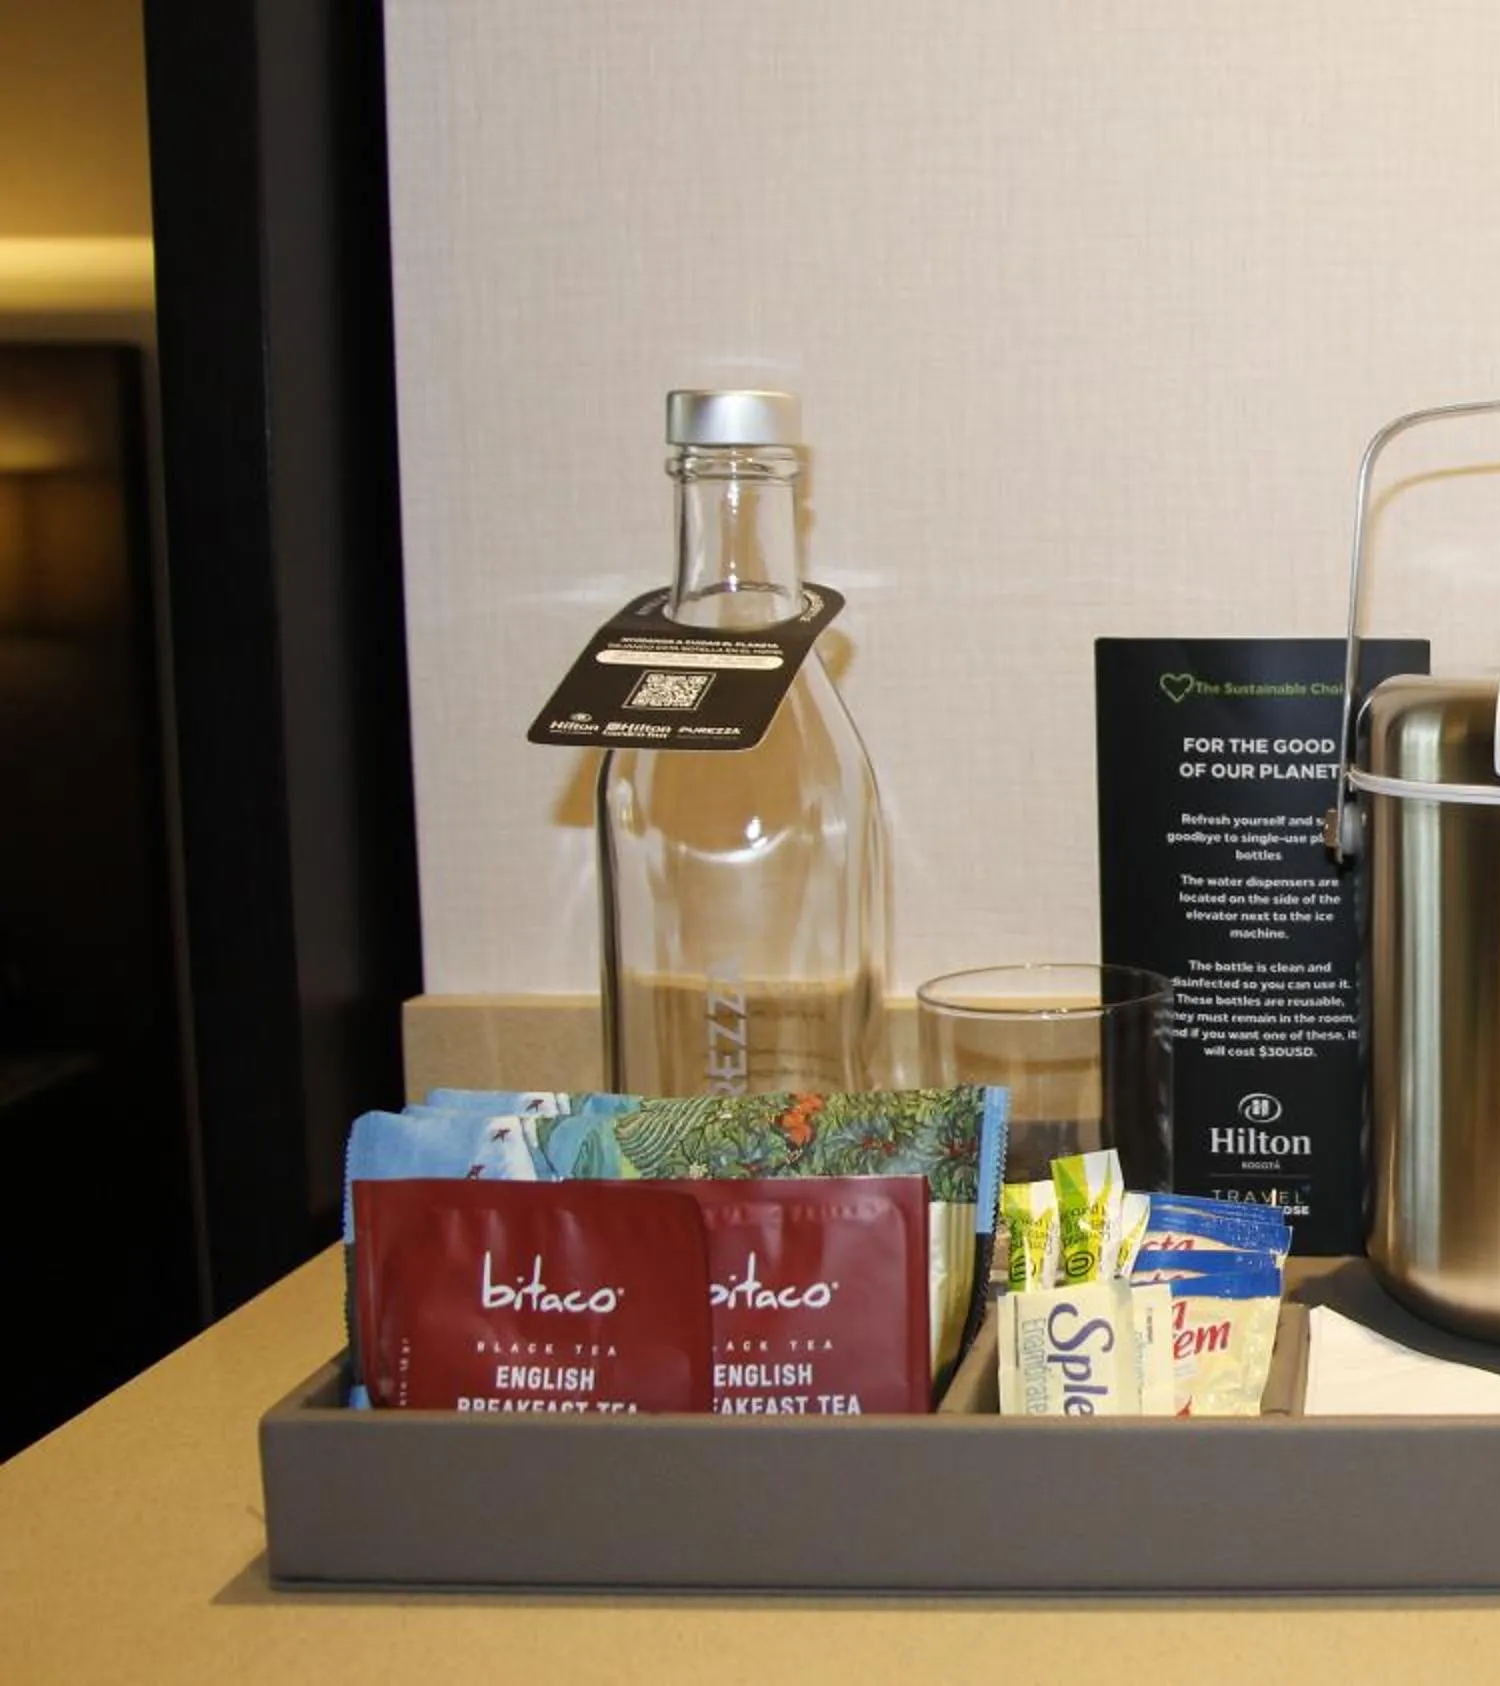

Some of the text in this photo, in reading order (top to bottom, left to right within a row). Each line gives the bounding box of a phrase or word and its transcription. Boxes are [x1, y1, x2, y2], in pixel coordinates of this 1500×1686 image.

[1196, 682, 1345, 695] The Sustainable Choi
[1184, 738, 1335, 754] FOR THE GOOD
[1180, 763, 1341, 781] OF OUR PLANET
[1182, 814, 1231, 825] Refresh
[1234, 816, 1286, 828] yourself
[1288, 816, 1313, 826] and
[1167, 832, 1221, 844] goodbye
[1224, 833, 1238, 842] to
[1241, 833, 1307, 845] single-use
[1236, 850, 1282, 860] bottles
[1181, 874, 1204, 885] The
[1207, 877, 1242, 886] water
[1246, 877, 1315, 888] dispensers
[1180, 892, 1341, 904] located on the side of the
[1186, 910, 1333, 921] elevator next to the ice
[1230, 928, 1288, 938] machine.
[1189, 960, 1331, 972] The bottle is clean and
[1261, 982, 1285, 992] you
[1288, 982, 1311, 990] can
[1176, 994, 1213, 1004] These
[1216, 995, 1261, 1006] bottles
[1264, 998, 1285, 1006] are
[1197, 1013, 1228, 1022] must
[1232, 1014, 1277, 1023] remain
[1280, 1014, 1291, 1023] in
[1294, 1014, 1315, 1023] the
[1191, 1028, 1199, 1037] if
[1202, 1031, 1226, 1041] you
[1228, 1031, 1259, 1040] want
[1263, 1032, 1286, 1040] one
[1290, 1030, 1303, 1040] of
[1204, 1046, 1225, 1056] will
[1228, 1048, 1255, 1056] cost
[1210, 1127, 1312, 1154] Hilton
[1212, 1189, 1304, 1205] TRAVEL
[482, 1252, 625, 1313] bitaco
[477, 1342, 617, 1356] BLACK TEA
[713, 1339, 834, 1350] ACK TEA
[1047, 1303, 1114, 1416] Sple
[495, 1365, 595, 1391] ENGLISH
[714, 1363, 813, 1385] ENGLISH
[817, 1395, 860, 1415] TEA
